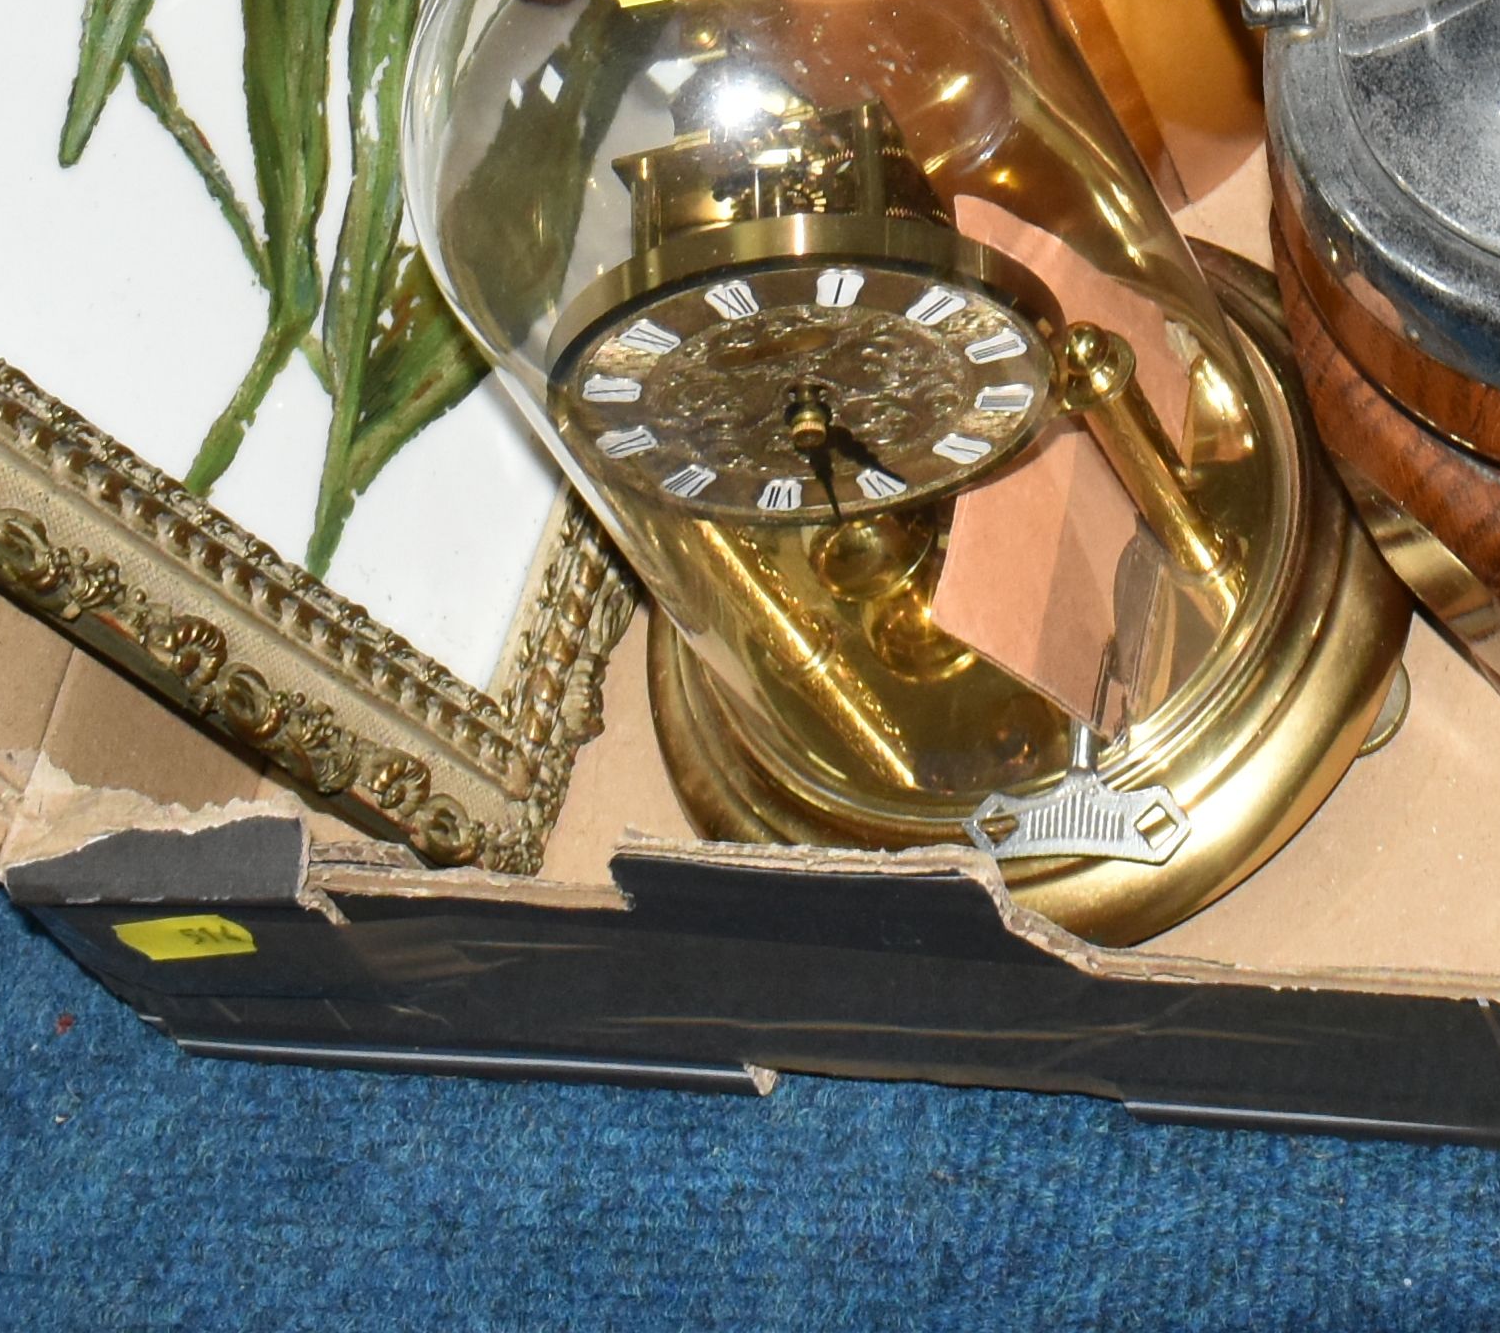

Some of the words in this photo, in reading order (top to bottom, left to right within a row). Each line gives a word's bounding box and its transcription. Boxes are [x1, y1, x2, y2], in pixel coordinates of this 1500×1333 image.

[711, 286, 756, 320] XII
[916, 295, 955, 323] II
[766, 485, 793, 510] VII
[179, 924, 244, 945] 514
